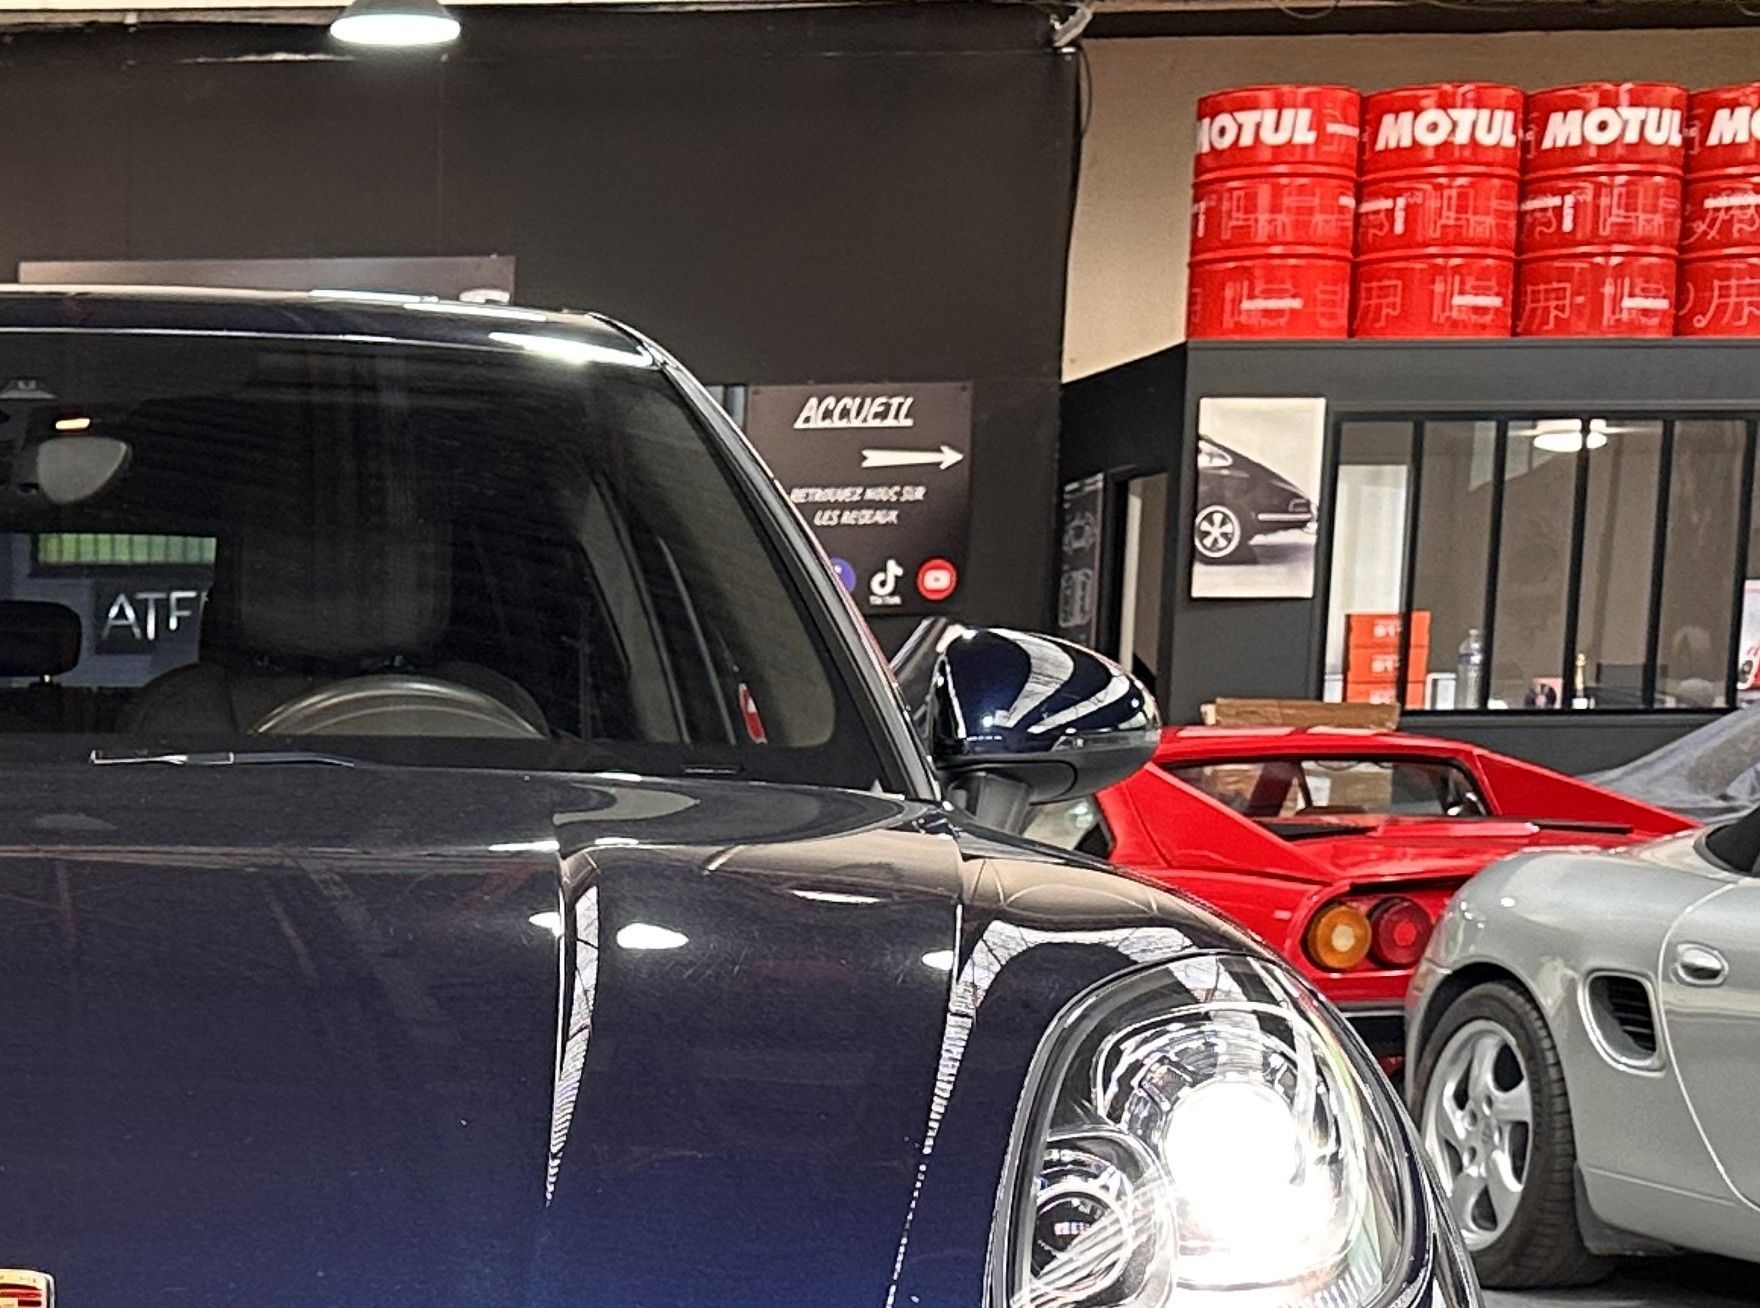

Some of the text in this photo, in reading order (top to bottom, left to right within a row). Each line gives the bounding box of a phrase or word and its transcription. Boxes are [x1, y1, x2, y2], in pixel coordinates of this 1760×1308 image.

[1374, 107, 1517, 151] MOTUL
[1540, 106, 1683, 149] MOTUL
[793, 395, 914, 428] ACCUEIL
[813, 509, 840, 525] LES
